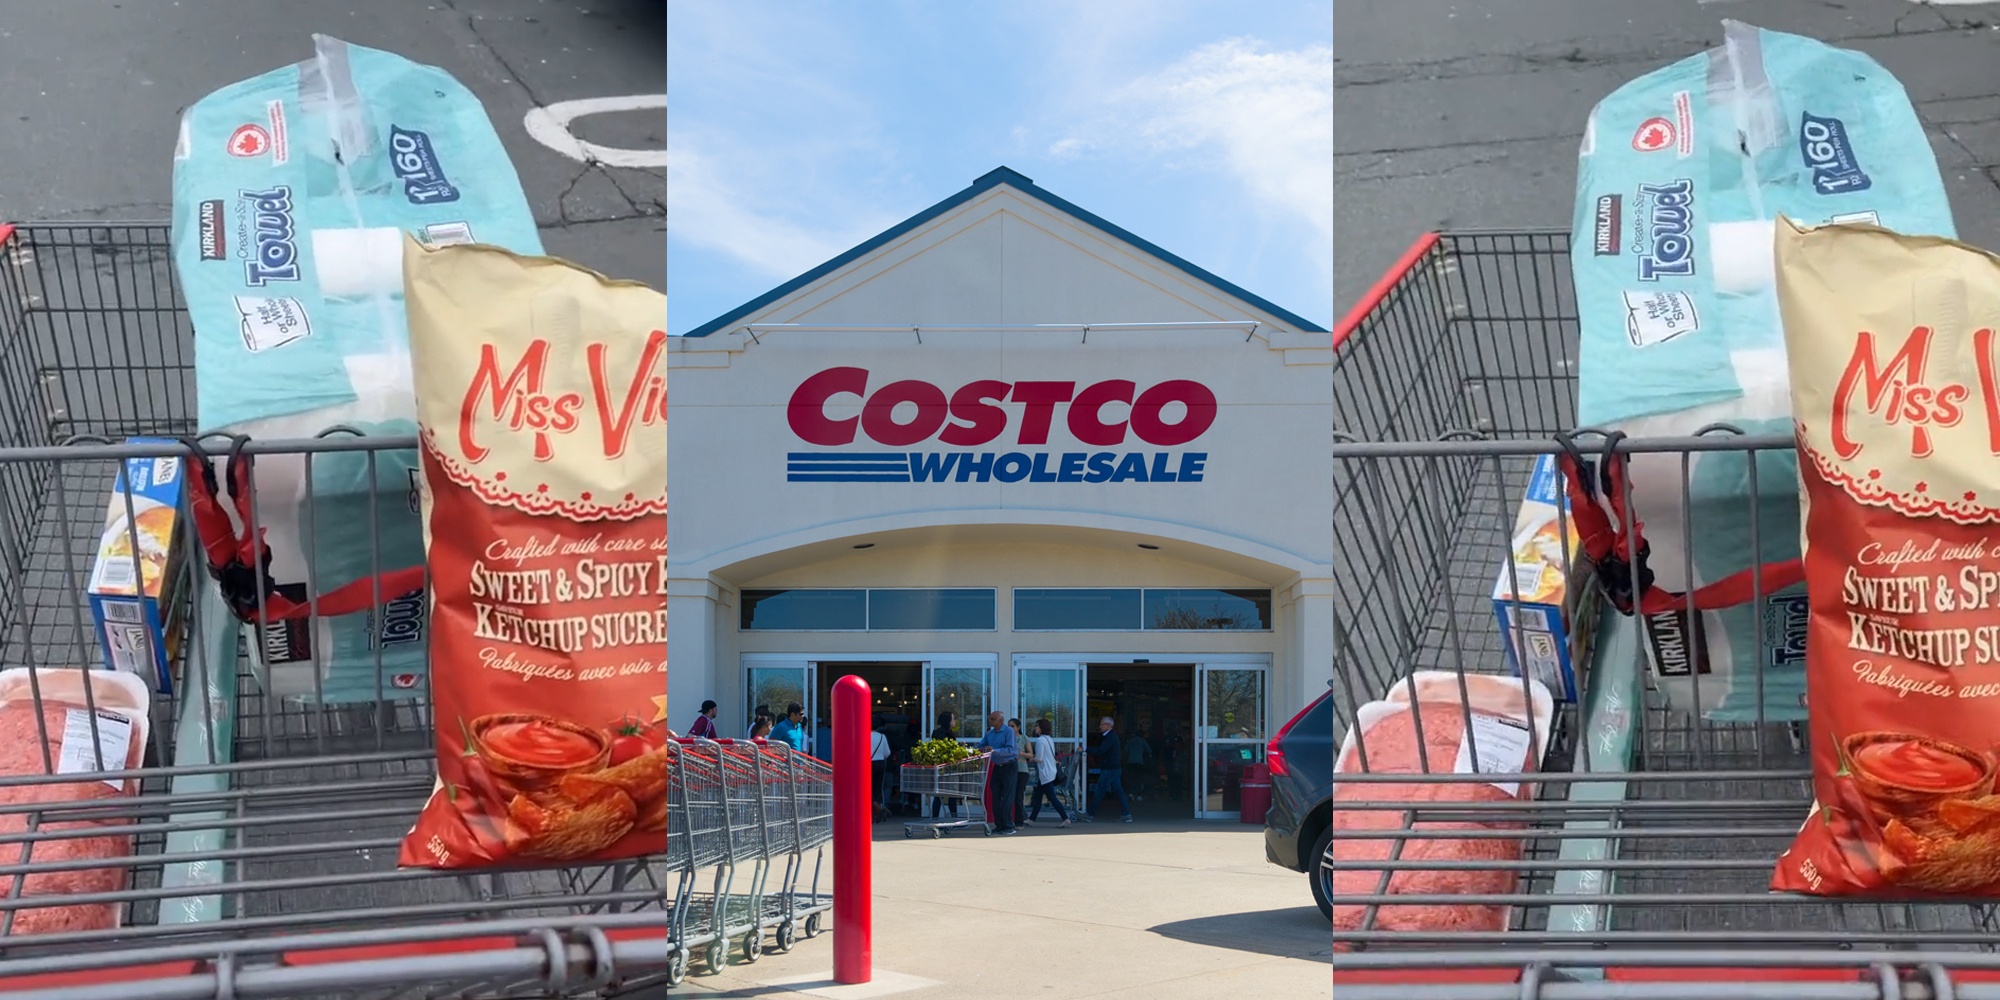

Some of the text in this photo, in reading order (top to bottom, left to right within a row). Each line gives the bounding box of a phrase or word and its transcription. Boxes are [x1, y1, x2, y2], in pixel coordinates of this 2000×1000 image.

[393, 133, 427, 178] 160
[1804, 121, 1838, 169] 160
[202, 201, 214, 259] KIRKLAND
[239, 186, 300, 287] Towel
[1597, 196, 1612, 252] KIRKLAND
[1637, 178, 1695, 281] Towel
[275, 320, 288, 334] or
[1663, 315, 1676, 328] or
[458, 339, 583, 462] Miss
[787, 366, 1217, 446] COSTCO
[1830, 326, 1970, 460] Miss
[157, 457, 174, 483] ANES
[909, 452, 1208, 483] WHOLESALE
[485, 534, 560, 567] Crafted
[561, 533, 602, 555] with
[604, 538, 645, 551] care
[1858, 538, 1942, 573] Crafted
[1942, 537, 1988, 560] with
[470, 560, 551, 605] SWEET
[555, 568, 574, 602] &
[577, 559, 652, 600] SPICY
[1843, 565, 1930, 614] SWEET
[1935, 574, 1955, 612] &
[266, 619, 290, 661] KIRKL
[473, 602, 667, 653] KETCHUP SUCRÉ
[1652, 610, 1690, 673] KIRKLAN
[1847, 611, 1971, 667] KETCHUP
[479, 647, 574, 682] Fabriquées
[578, 665, 616, 682] avec
[619, 658, 653, 676] soin
[1852, 659, 2000, 699] Fabriquées avec
